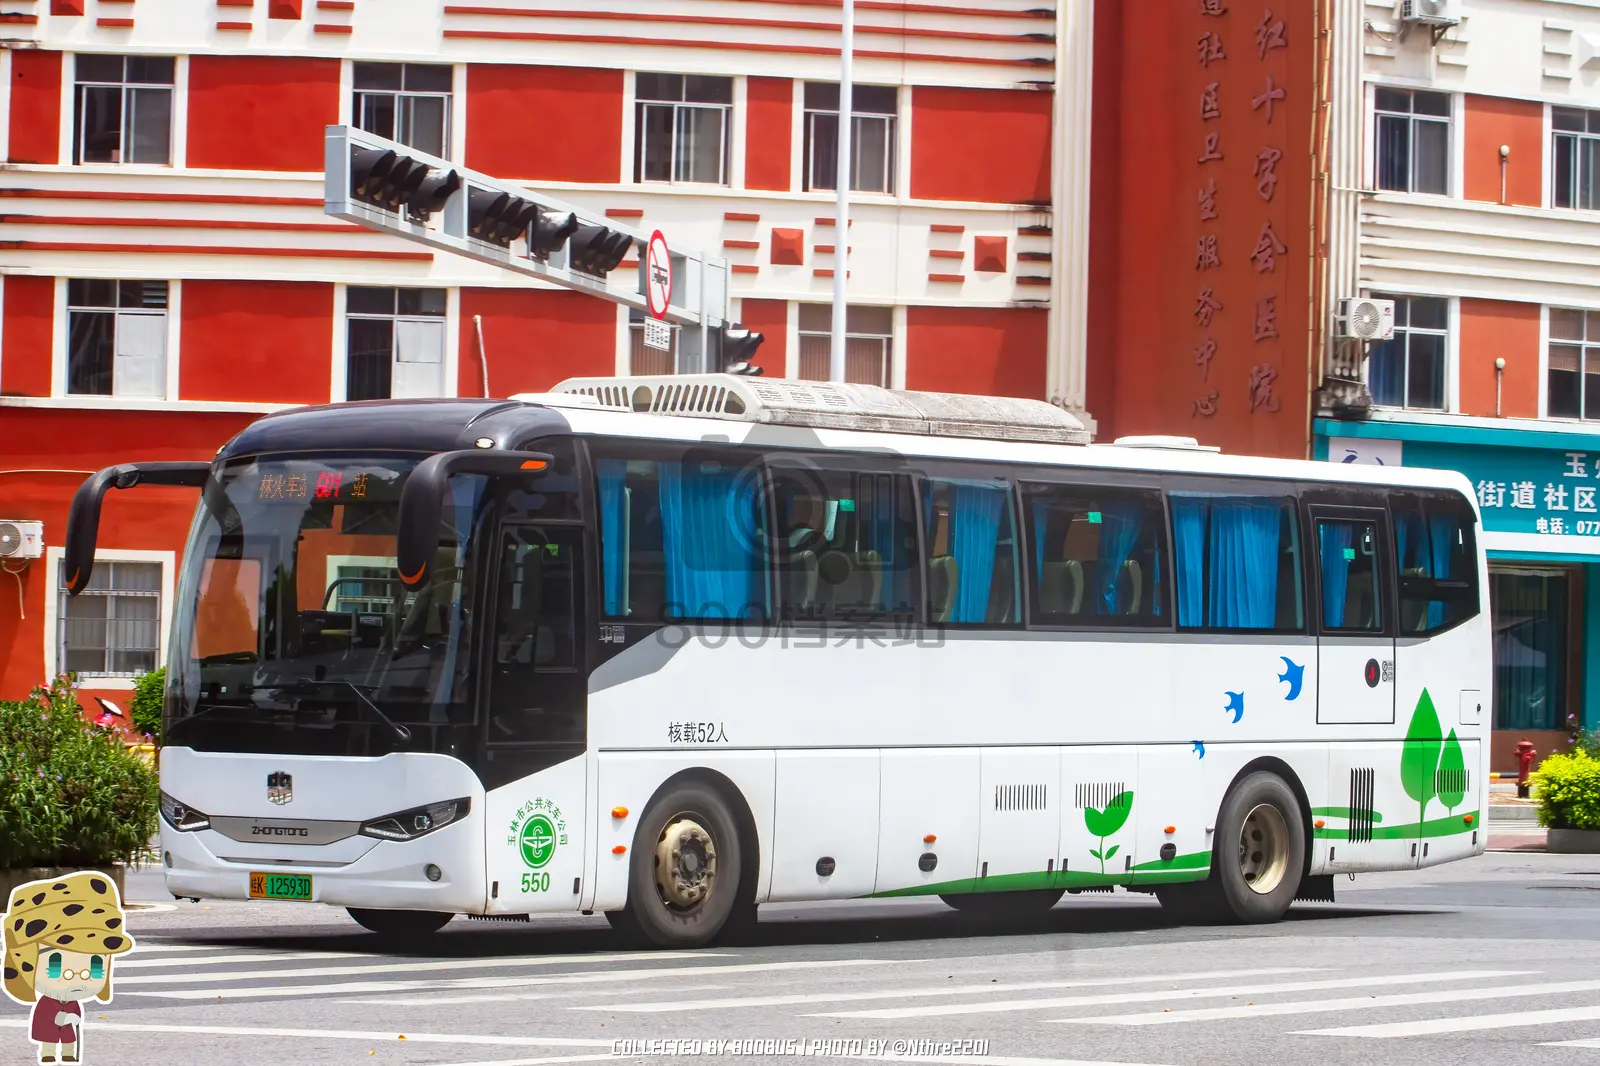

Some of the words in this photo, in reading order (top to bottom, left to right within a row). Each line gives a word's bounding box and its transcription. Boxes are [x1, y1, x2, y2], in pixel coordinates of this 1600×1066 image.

[1477, 479, 1598, 513] 街道社区
[668, 722, 729, 743] 核载52人
[251, 826, 308, 837] ZHONGTONG
[507, 797, 568, 846] 玉林市公共汽车公司
[521, 872, 550, 893] 550
